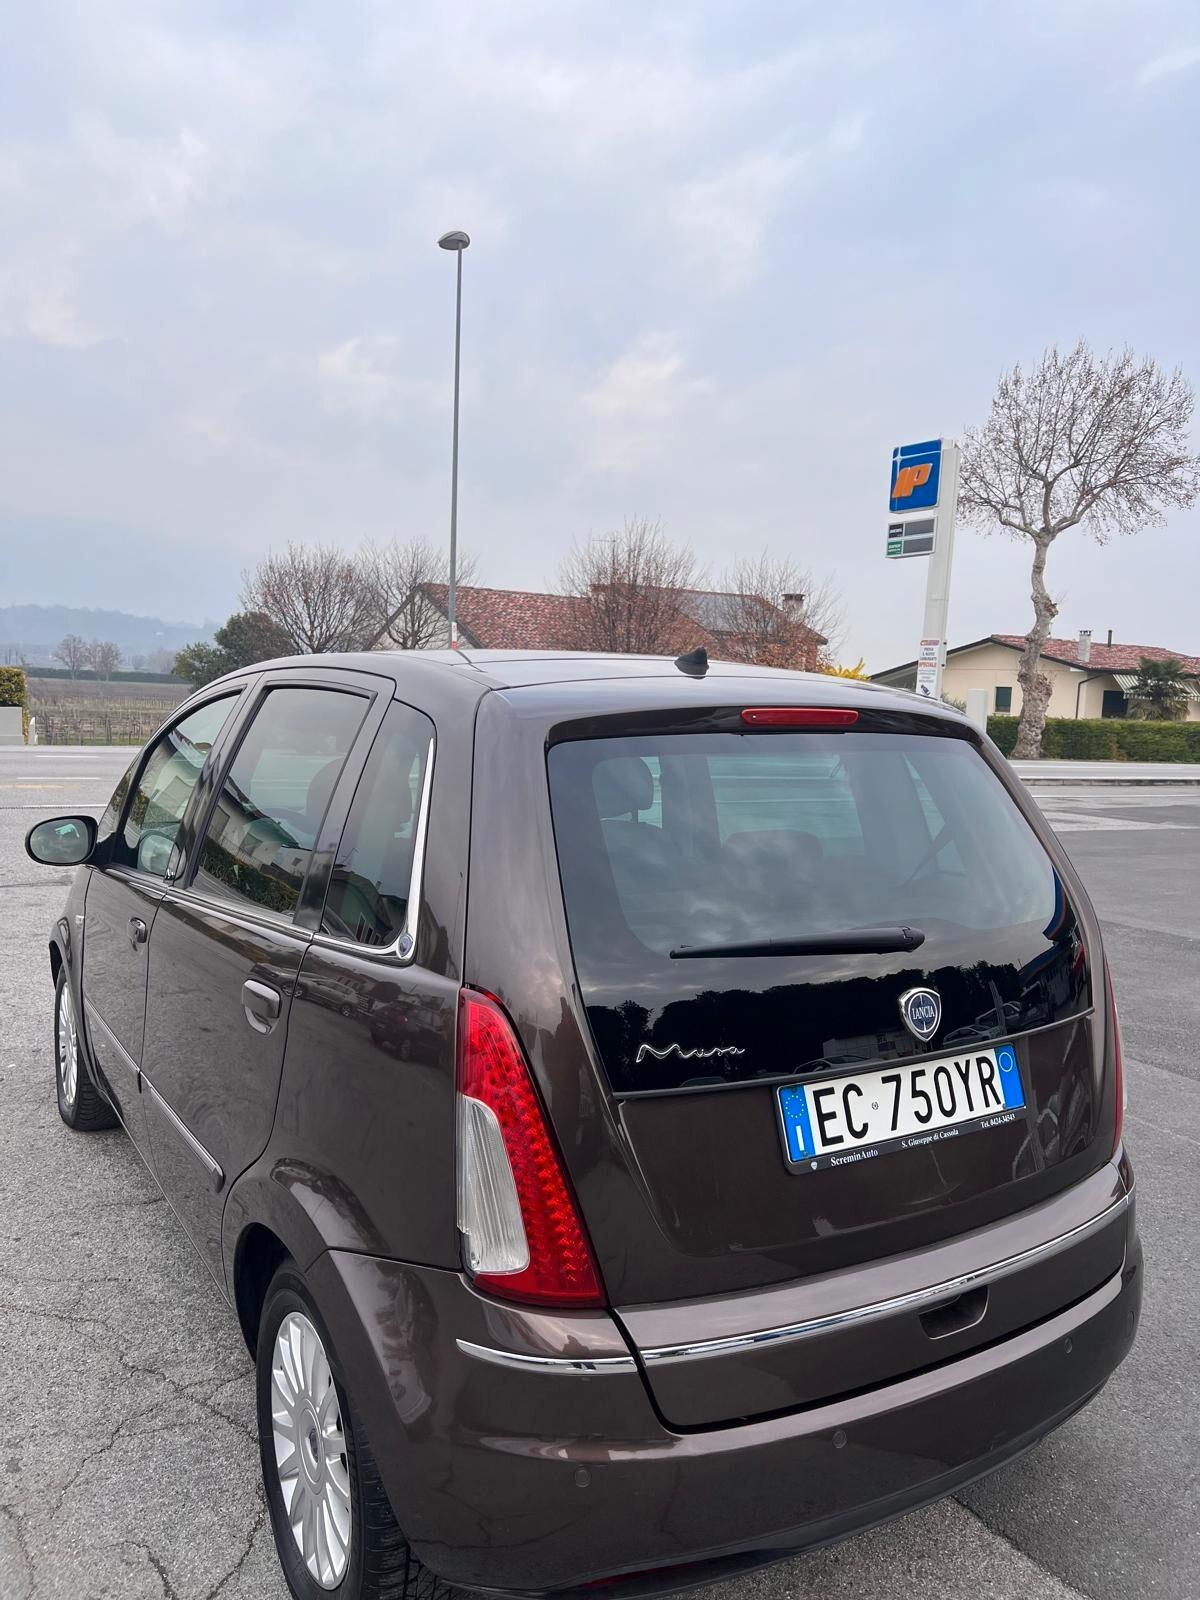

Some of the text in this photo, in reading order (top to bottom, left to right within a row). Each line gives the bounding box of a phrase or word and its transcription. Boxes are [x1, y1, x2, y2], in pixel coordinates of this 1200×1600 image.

[892, 462, 934, 498] IP
[912, 1005, 935, 1020] LANCIA
[813, 1055, 1002, 1147] EC 750YR
[901, 1128, 959, 1149] S. Giuseppe di Cassola
